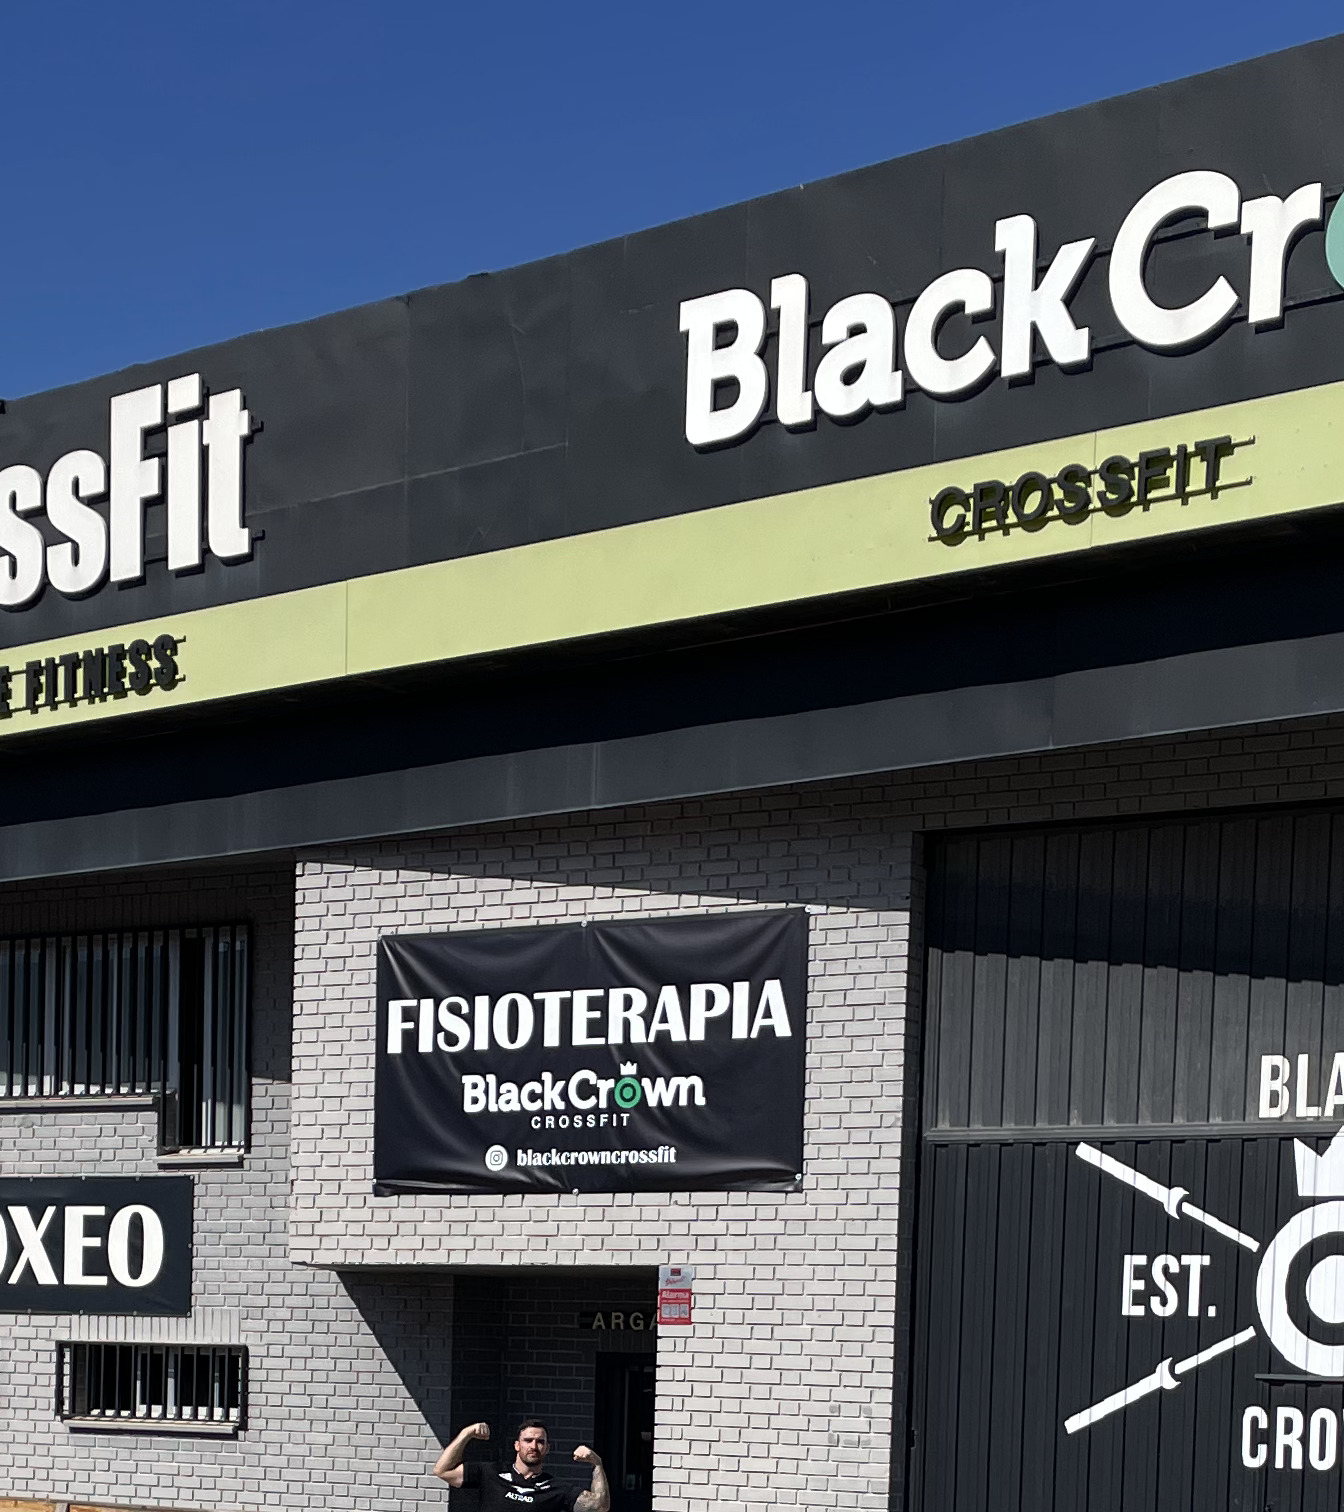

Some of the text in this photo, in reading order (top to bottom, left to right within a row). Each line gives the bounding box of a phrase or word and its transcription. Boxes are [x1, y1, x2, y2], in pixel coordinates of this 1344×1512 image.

[930, 435, 1234, 541] CROSSFIT
[25, 634, 179, 712] FITNESS
[386, 979, 793, 1055] FISIOTERAPIA
[517, 1145, 677, 1167] blackcrowncrossfit
[531, 1113, 631, 1129] CROSSFIT
[1121, 1254, 1217, 1318] EST.
